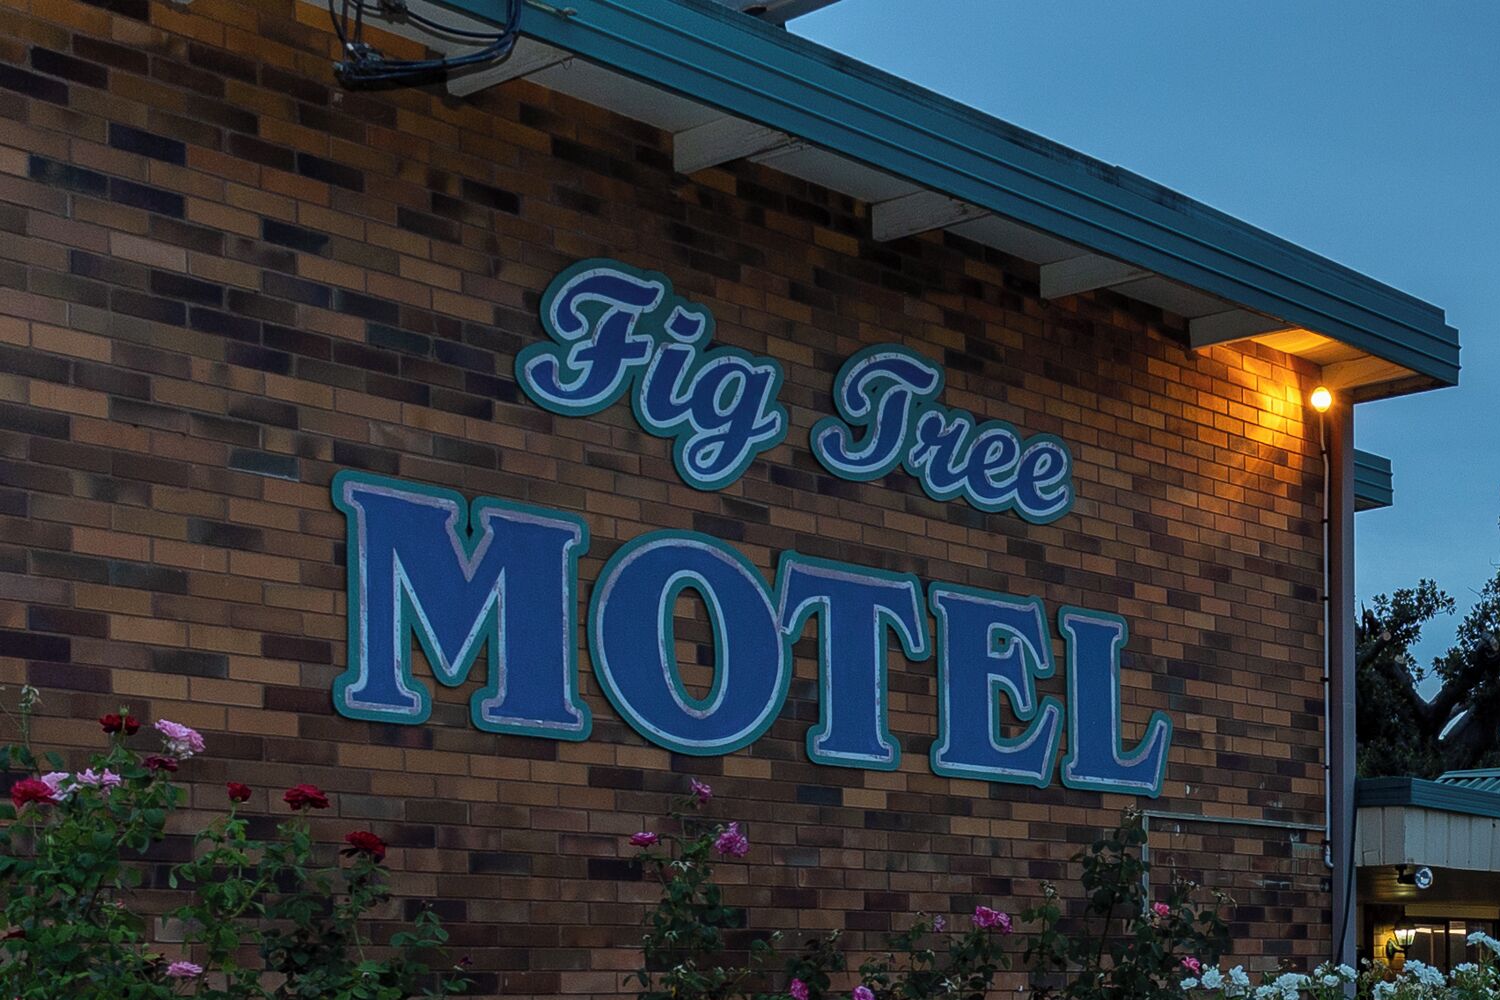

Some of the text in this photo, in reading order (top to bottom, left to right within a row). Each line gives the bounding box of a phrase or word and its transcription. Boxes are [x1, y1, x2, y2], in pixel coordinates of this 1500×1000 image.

[518, 262, 1072, 523] Fig Tree
[336, 474, 1170, 795] MOTEL
